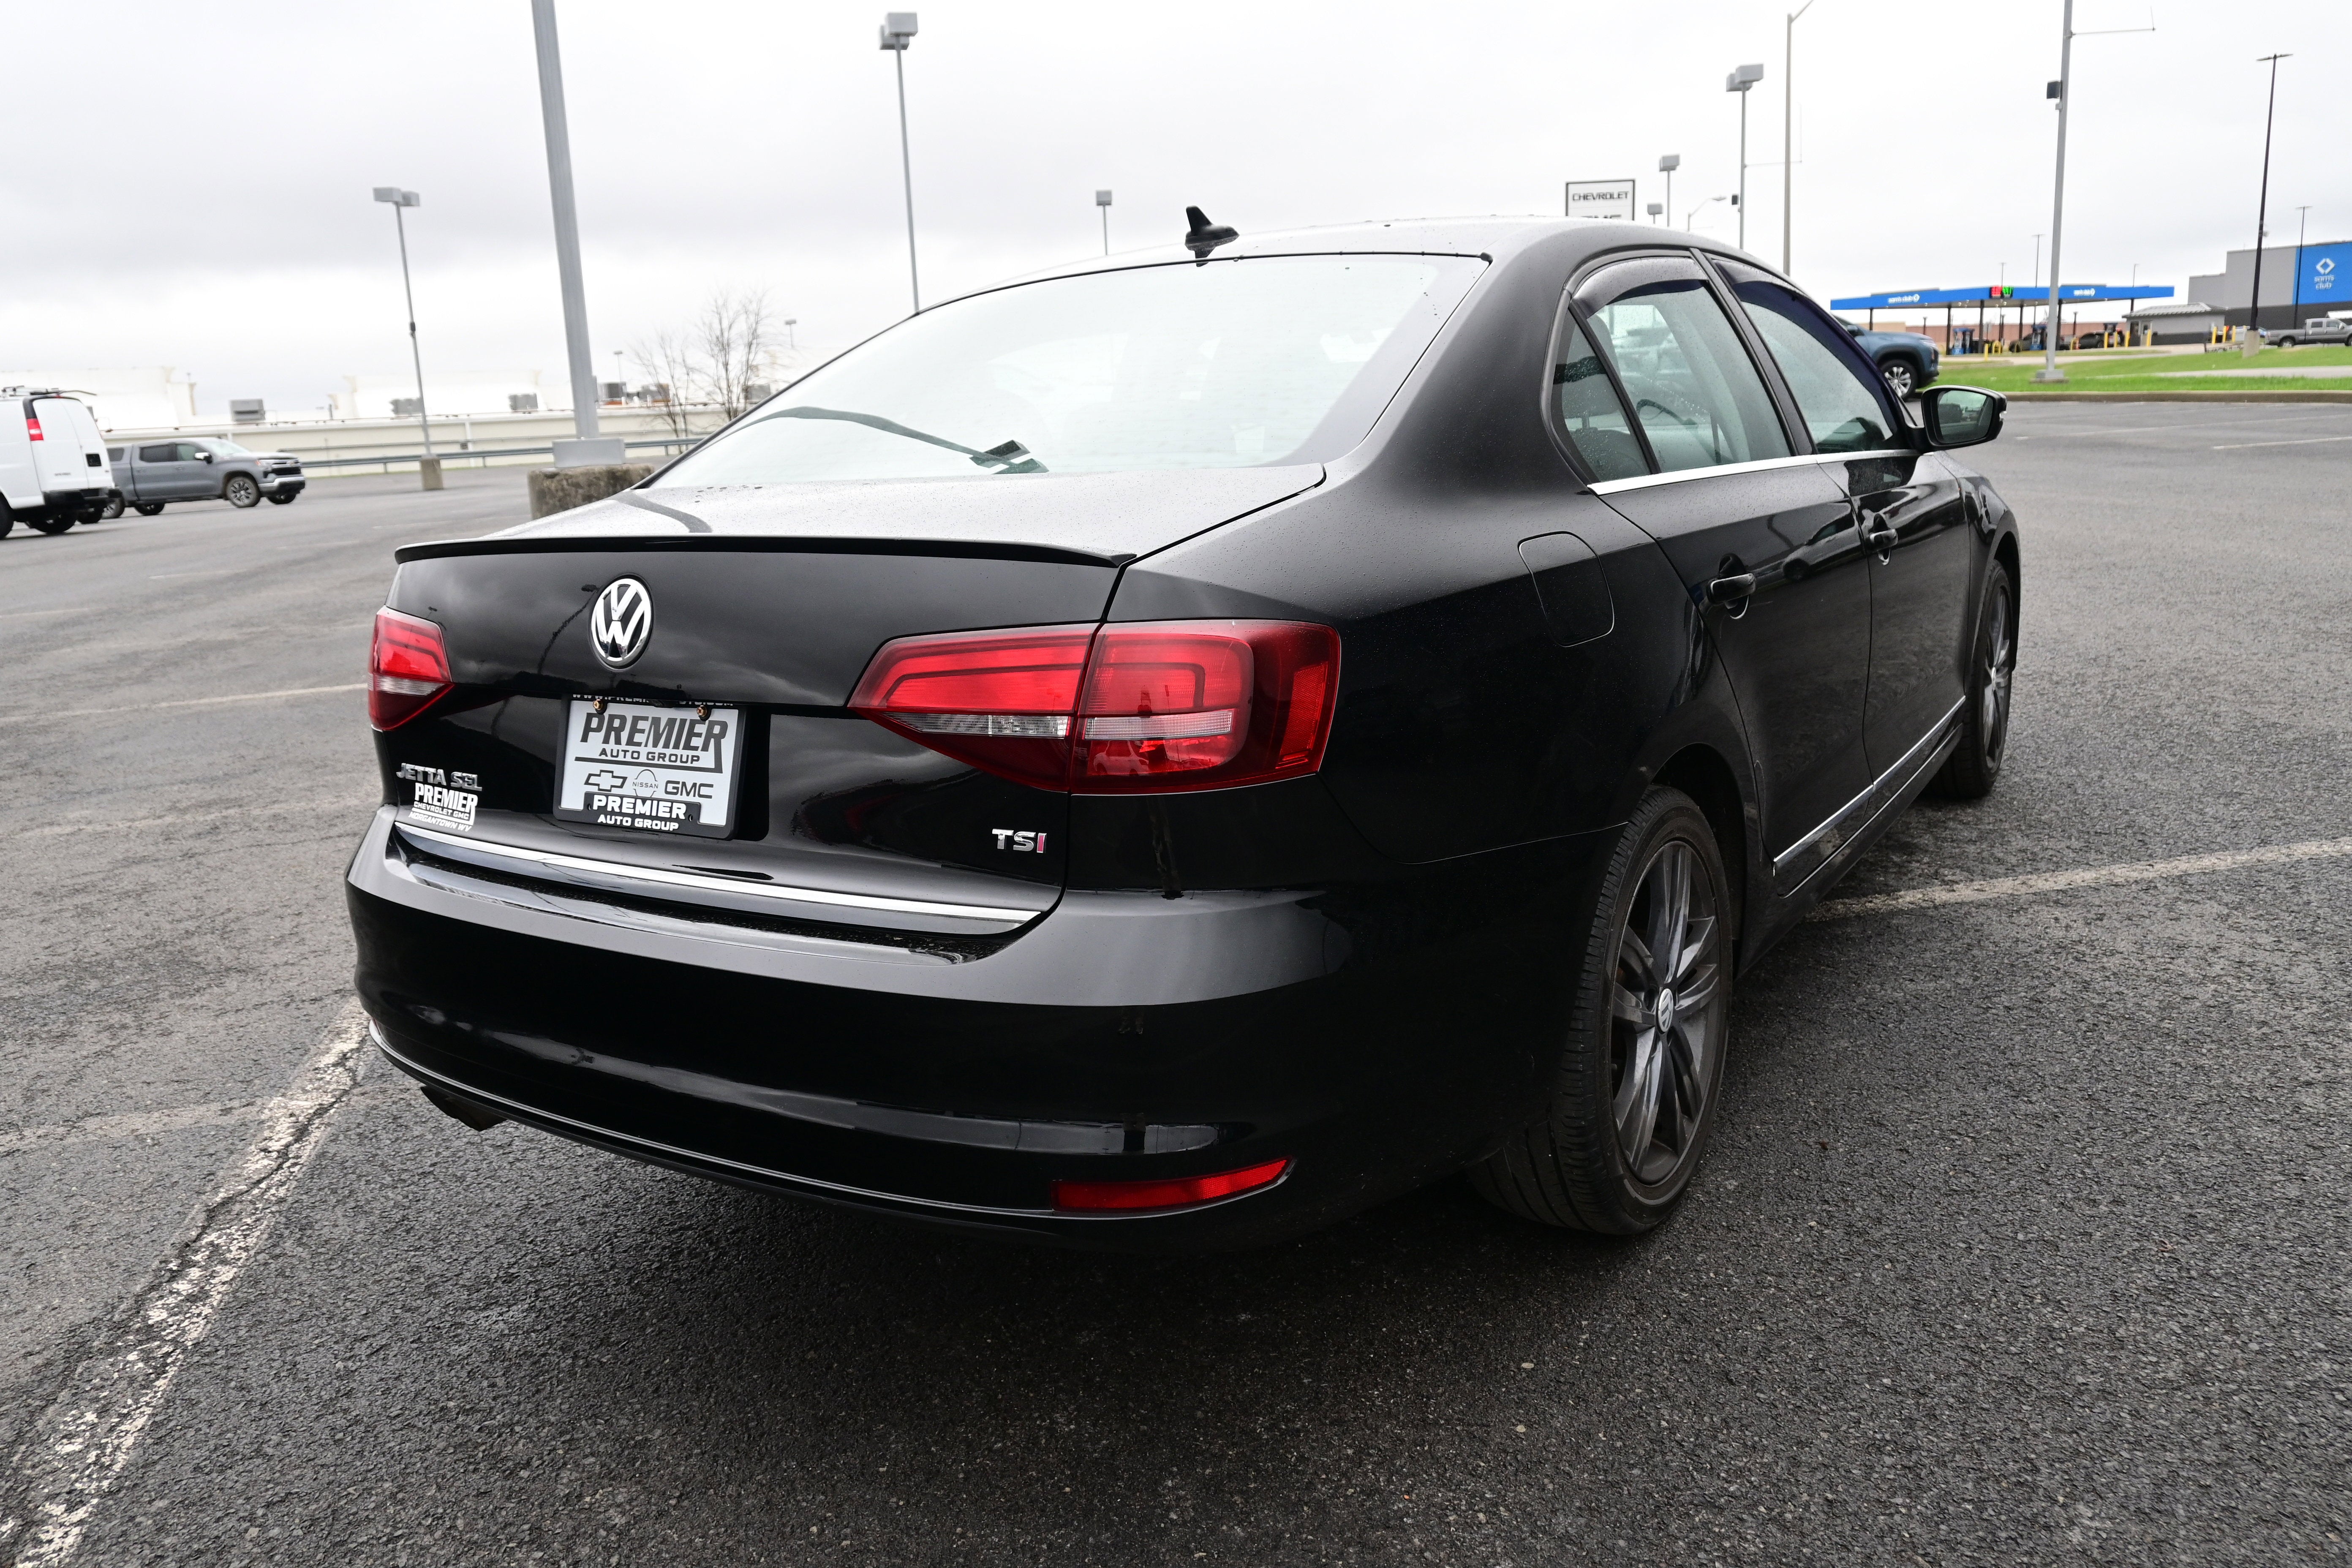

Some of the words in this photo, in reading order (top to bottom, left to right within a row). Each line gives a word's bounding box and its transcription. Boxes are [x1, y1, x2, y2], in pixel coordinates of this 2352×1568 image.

[1572, 191, 1629, 201] CHEVROLET
[580, 712, 728, 752] PREMIER
[599, 747, 640, 760] AUTO
[646, 751, 700, 765] GROUP
[396, 762, 446, 786] JETTA
[450, 771, 482, 792] SEL
[414, 782, 478, 814] PREMIER
[664, 780, 714, 799] GMC
[414, 801, 453, 816] CHEVROLET
[453, 810, 470, 820] GMC
[593, 795, 687, 819] PREMIER
[408, 811, 458, 829] MORGANTOWN
[457, 822, 472, 832] WV
[597, 814, 632, 826] AUTO
[634, 818, 679, 831] GROUP
[992, 828, 1047, 853] TSI
